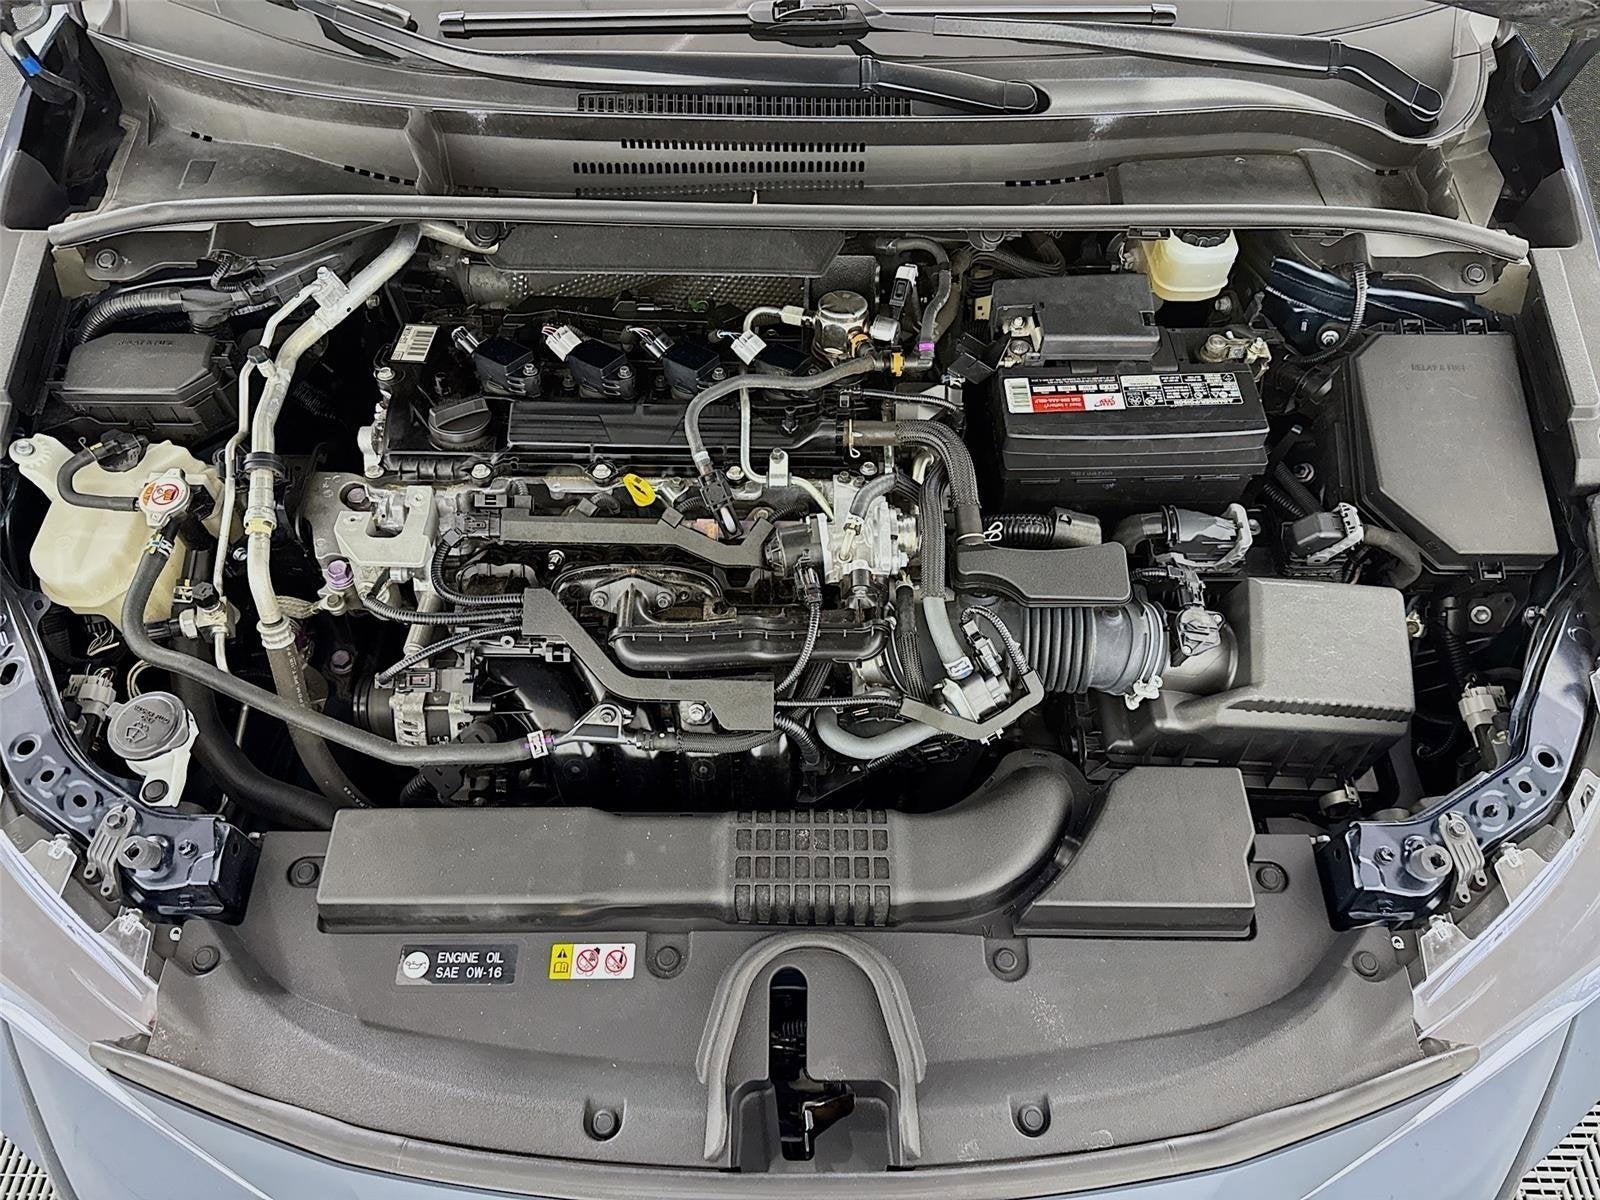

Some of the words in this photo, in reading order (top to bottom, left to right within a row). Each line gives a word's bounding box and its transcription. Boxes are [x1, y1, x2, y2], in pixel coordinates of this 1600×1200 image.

[437, 951, 480, 964] ENGINE
[486, 951, 505, 964] OIL
[435, 966, 459, 979] SAE
[466, 966, 503, 979] 0W-16
